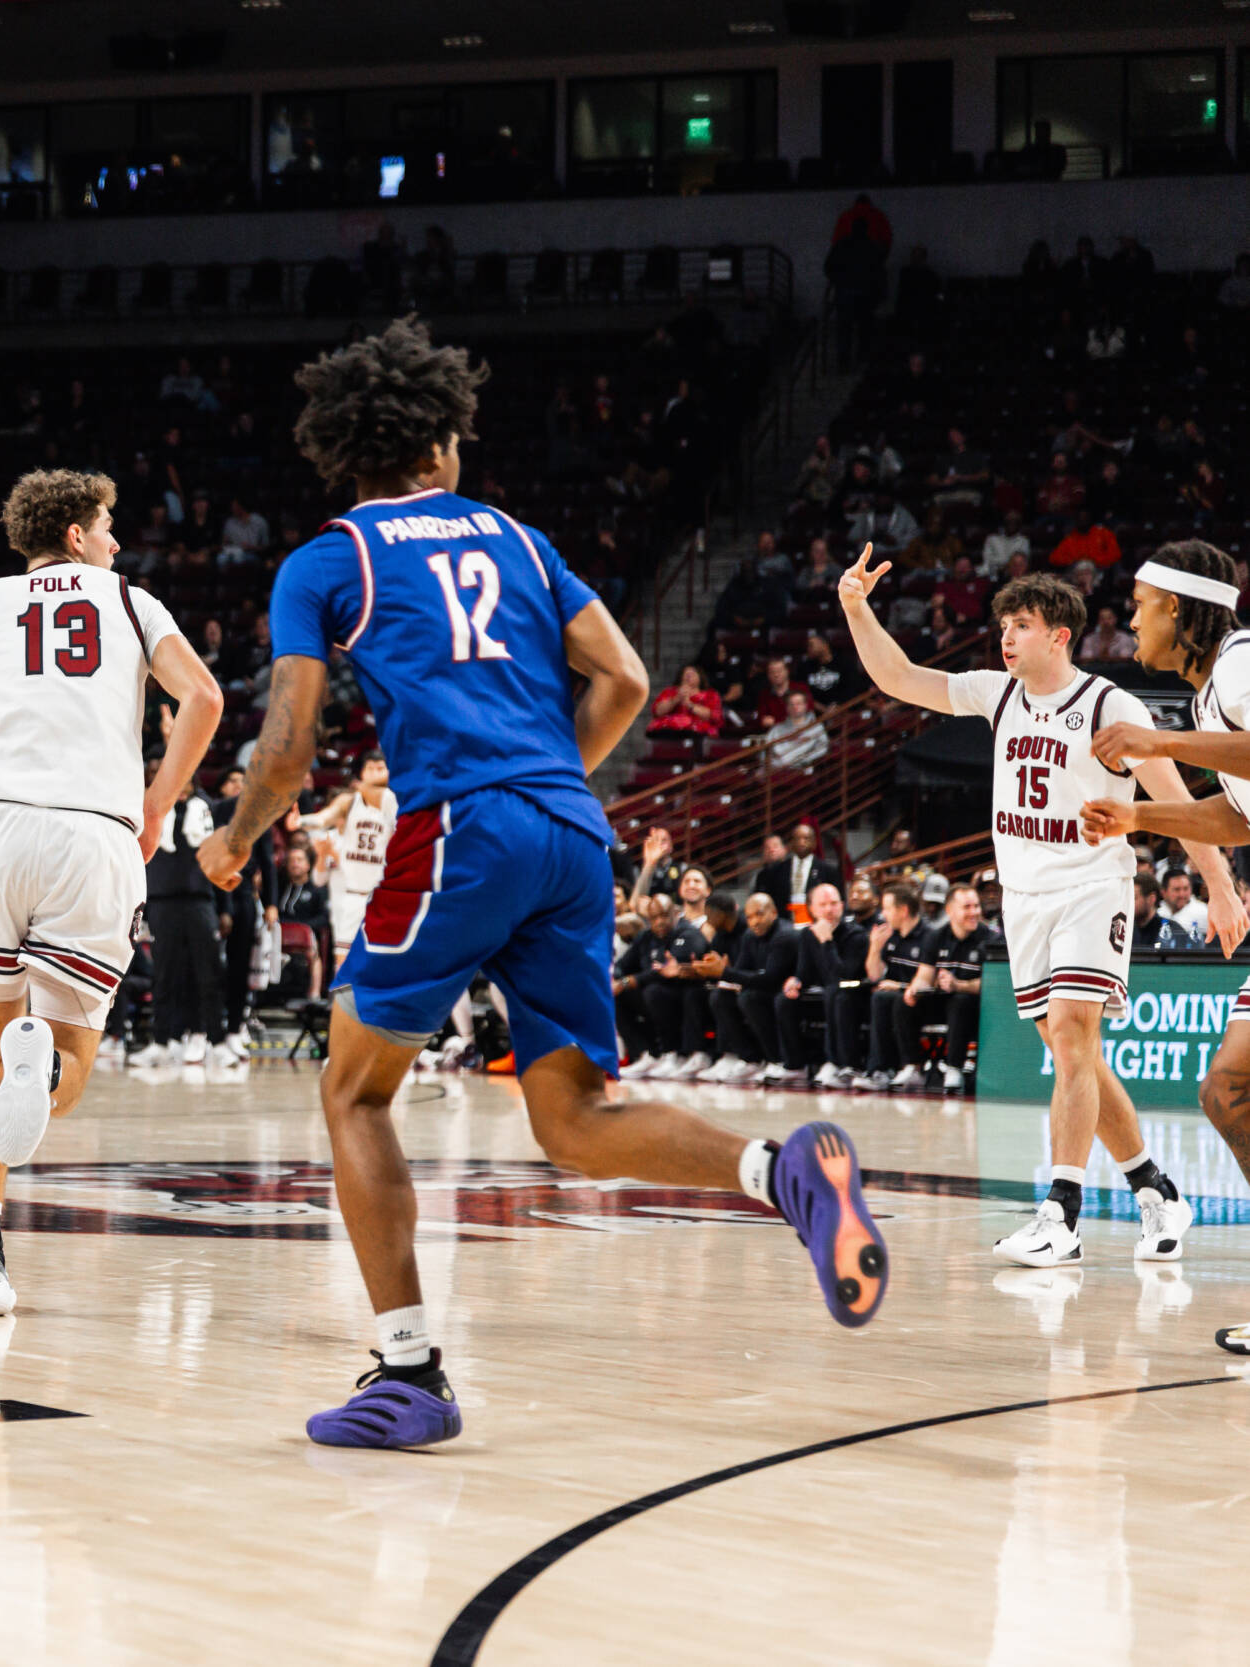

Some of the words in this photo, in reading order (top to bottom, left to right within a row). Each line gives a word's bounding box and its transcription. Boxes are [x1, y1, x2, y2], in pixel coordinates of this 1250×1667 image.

[375, 515, 479, 546] PARRISH
[470, 512, 502, 536] III
[30, 575, 82, 592] POLK
[426, 549, 513, 663] 12
[17, 599, 101, 677] 13
[1006, 736, 1068, 769] SOUTH
[1016, 765, 1050, 809] 15
[358, 833, 377, 850] 55
[997, 811, 1079, 843] CAROLINA
